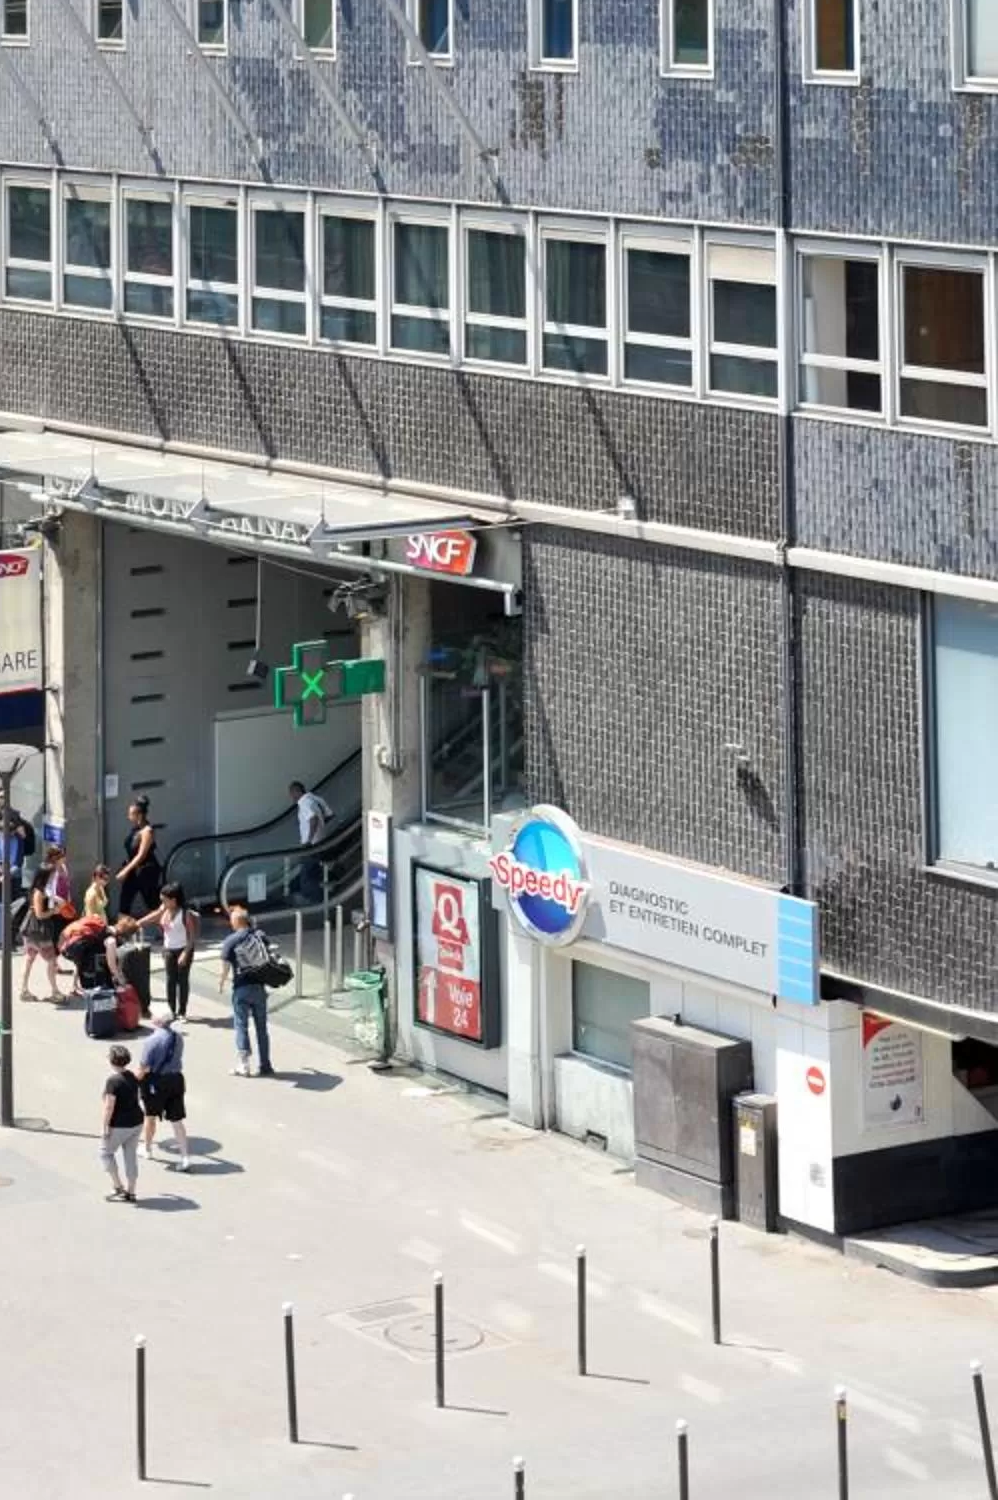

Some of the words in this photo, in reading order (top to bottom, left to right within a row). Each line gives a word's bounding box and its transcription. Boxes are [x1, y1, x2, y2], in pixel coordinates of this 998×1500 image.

[406, 533, 465, 565] SNCF
[490, 855, 584, 911] Speedy
[609, 880, 689, 915] DIAGNOSTIC
[609, 900, 625, 914] ET
[629, 904, 699, 939] ENTRETIEN
[703, 926, 769, 958] COMPLET
[448, 982, 474, 1009] Voie
[453, 1007, 468, 1029] 24
